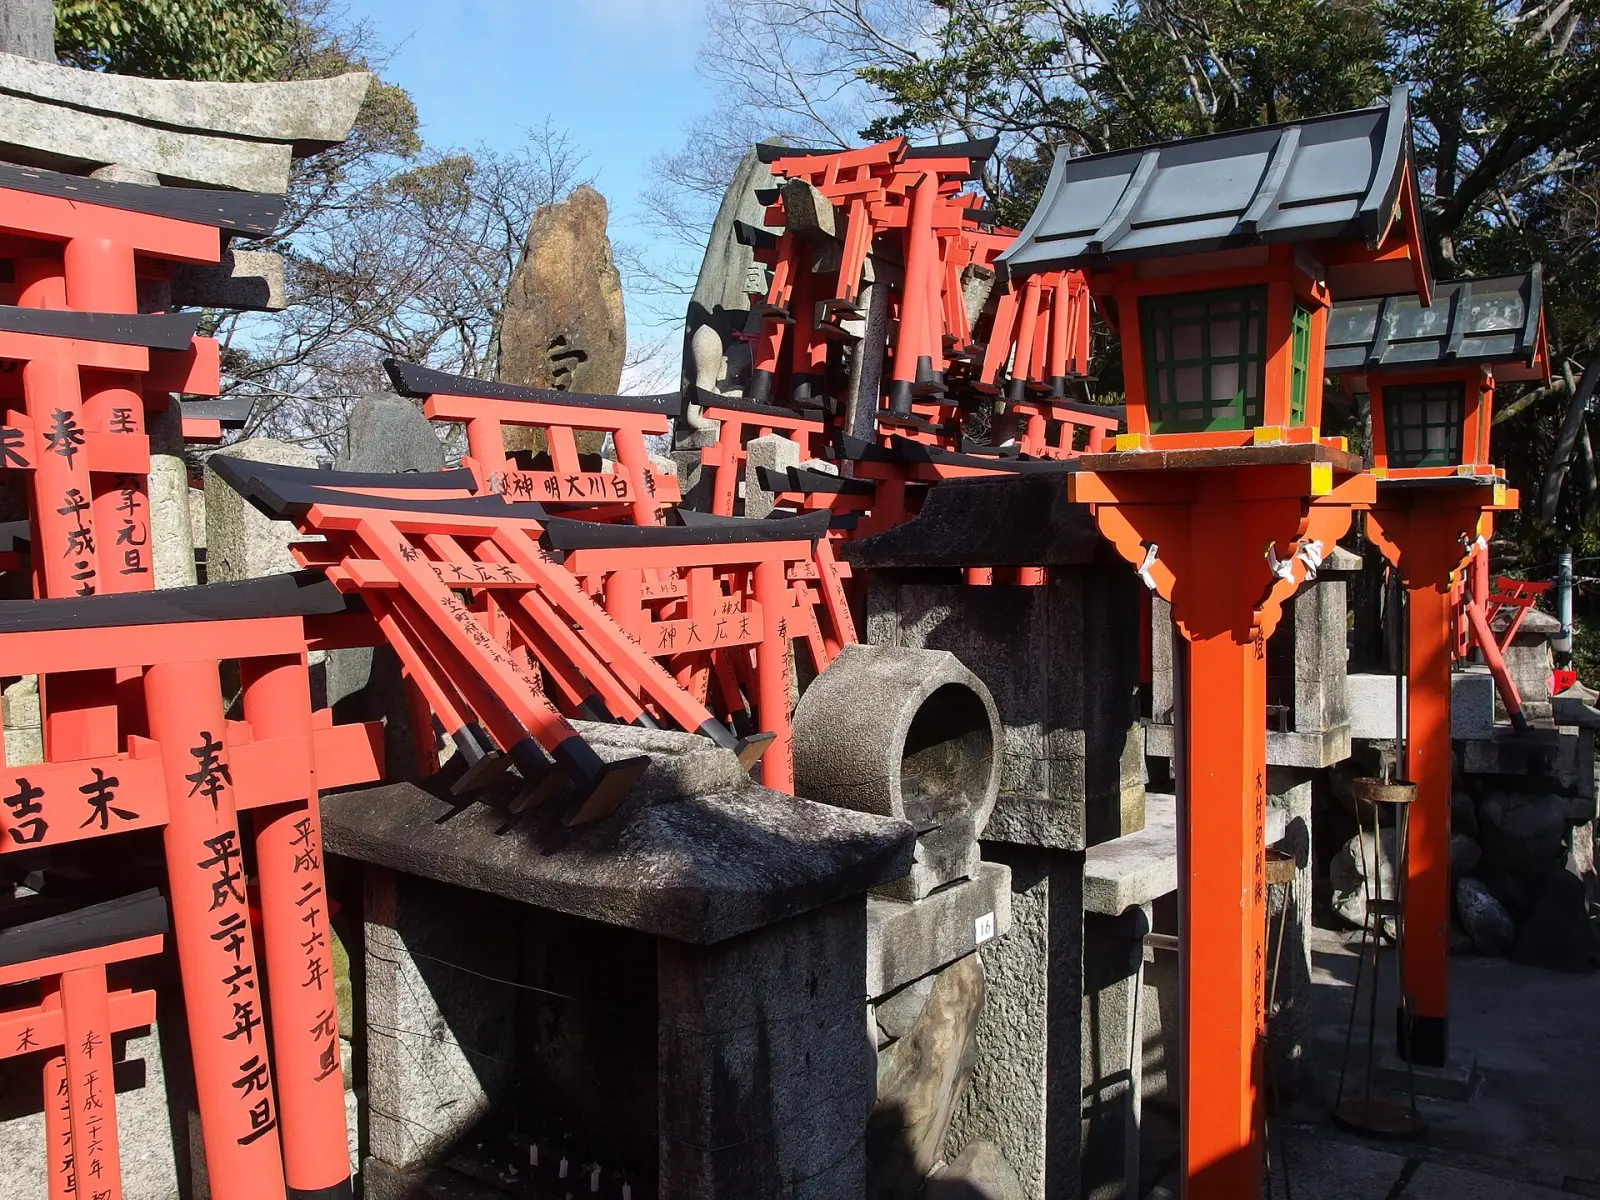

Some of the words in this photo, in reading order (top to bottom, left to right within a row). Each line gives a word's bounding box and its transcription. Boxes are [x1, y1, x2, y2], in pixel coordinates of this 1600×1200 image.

[43, 407, 86, 471] 奉
[185, 731, 234, 812] 奉
[81, 1029, 103, 1060] 奉
